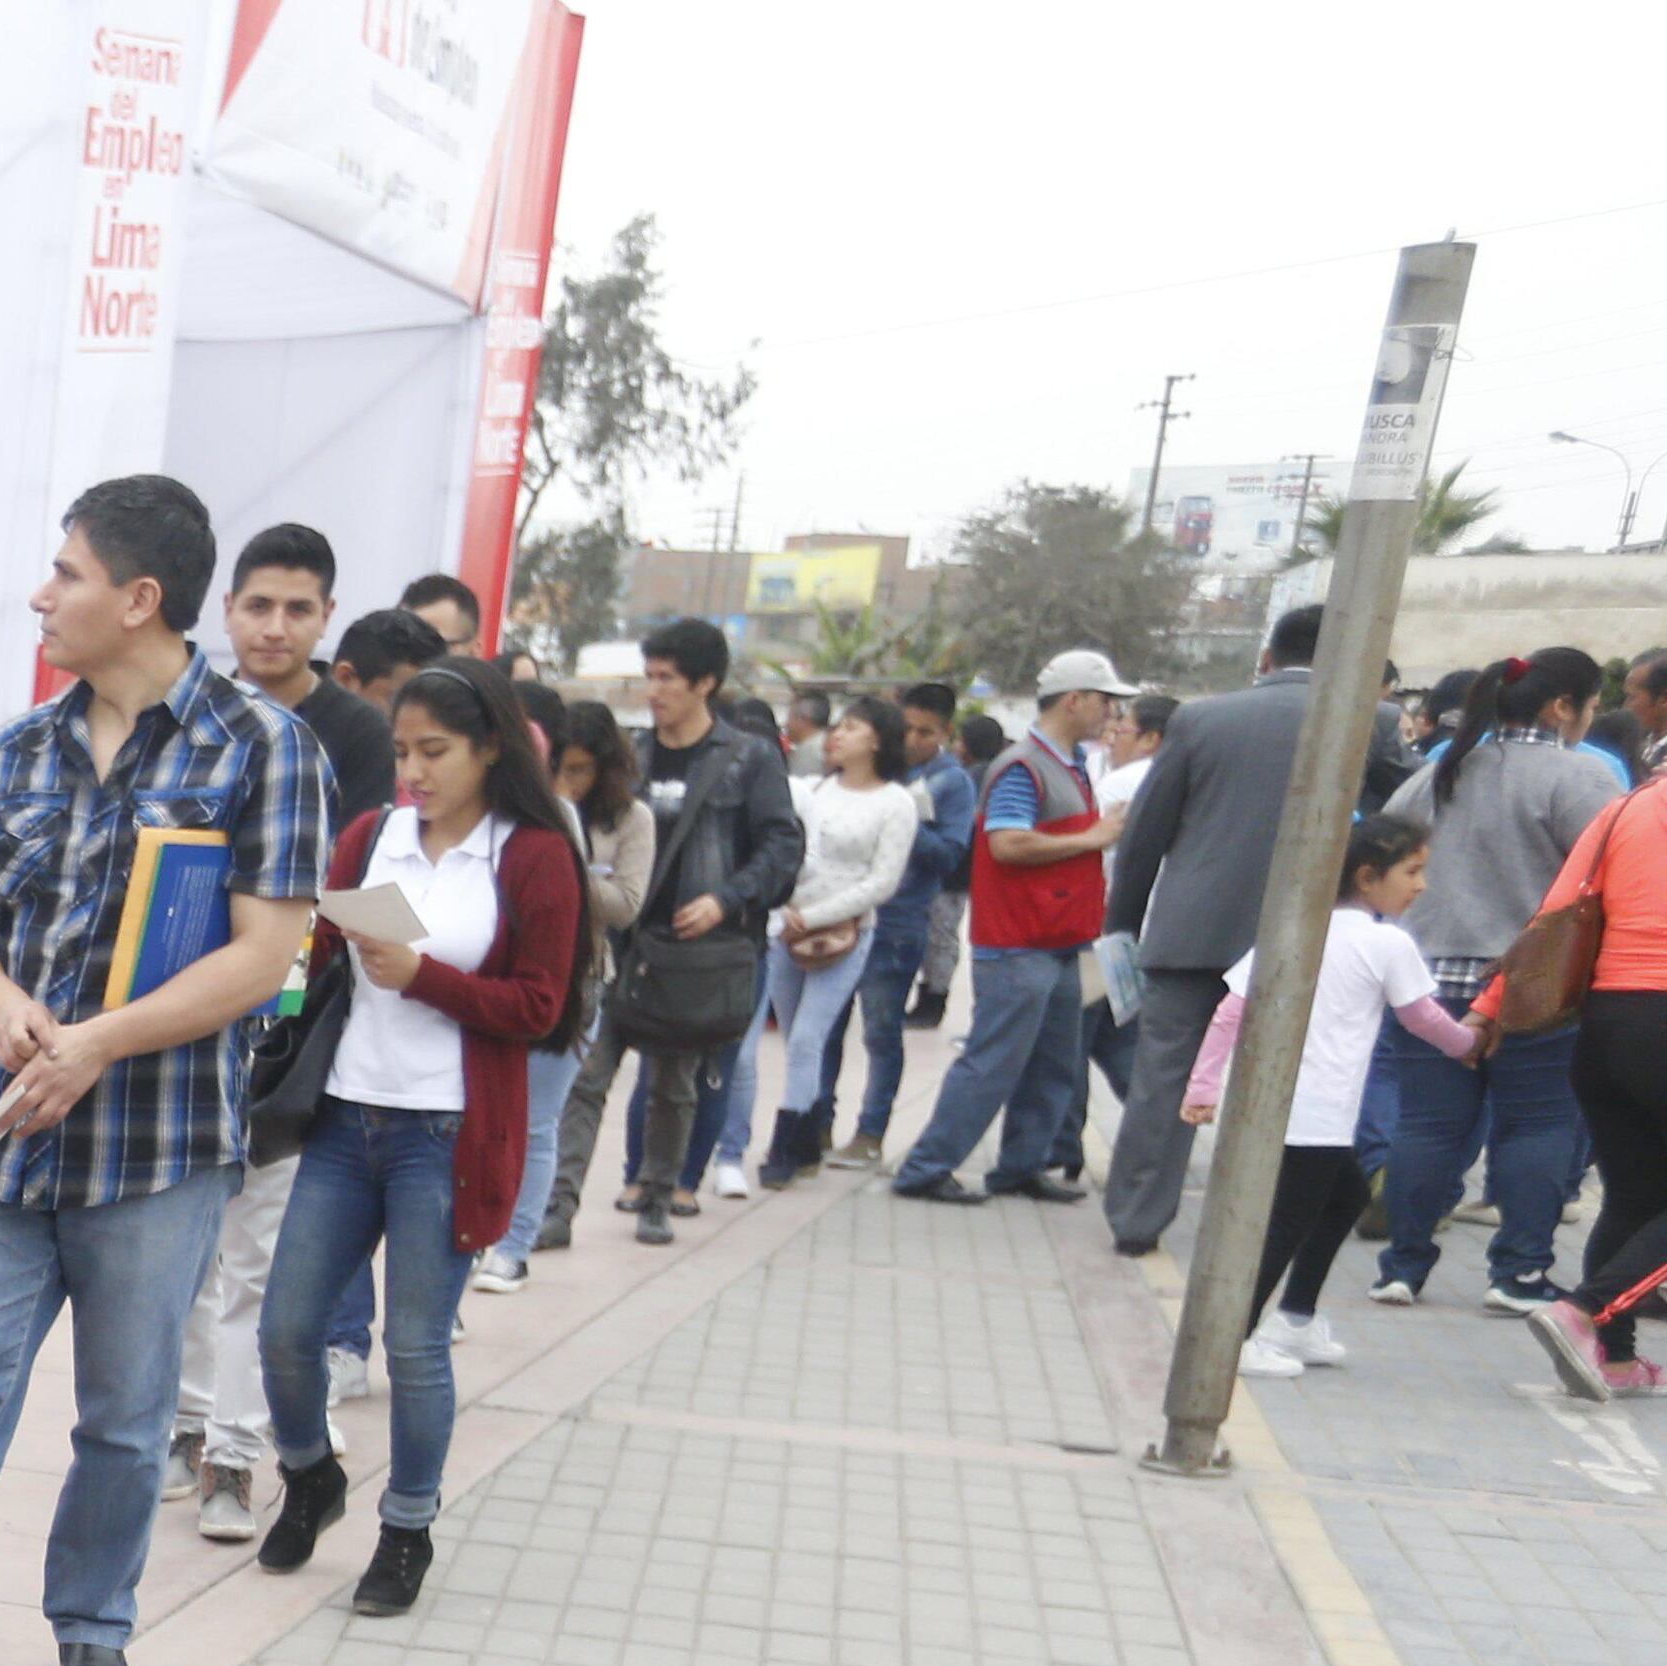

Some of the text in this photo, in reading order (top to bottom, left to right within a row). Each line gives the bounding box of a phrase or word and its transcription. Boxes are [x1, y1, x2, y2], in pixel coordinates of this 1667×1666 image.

[83, 106, 184, 184] Empleo
[91, 206, 161, 268] Lima
[80, 275, 156, 338] Norte
